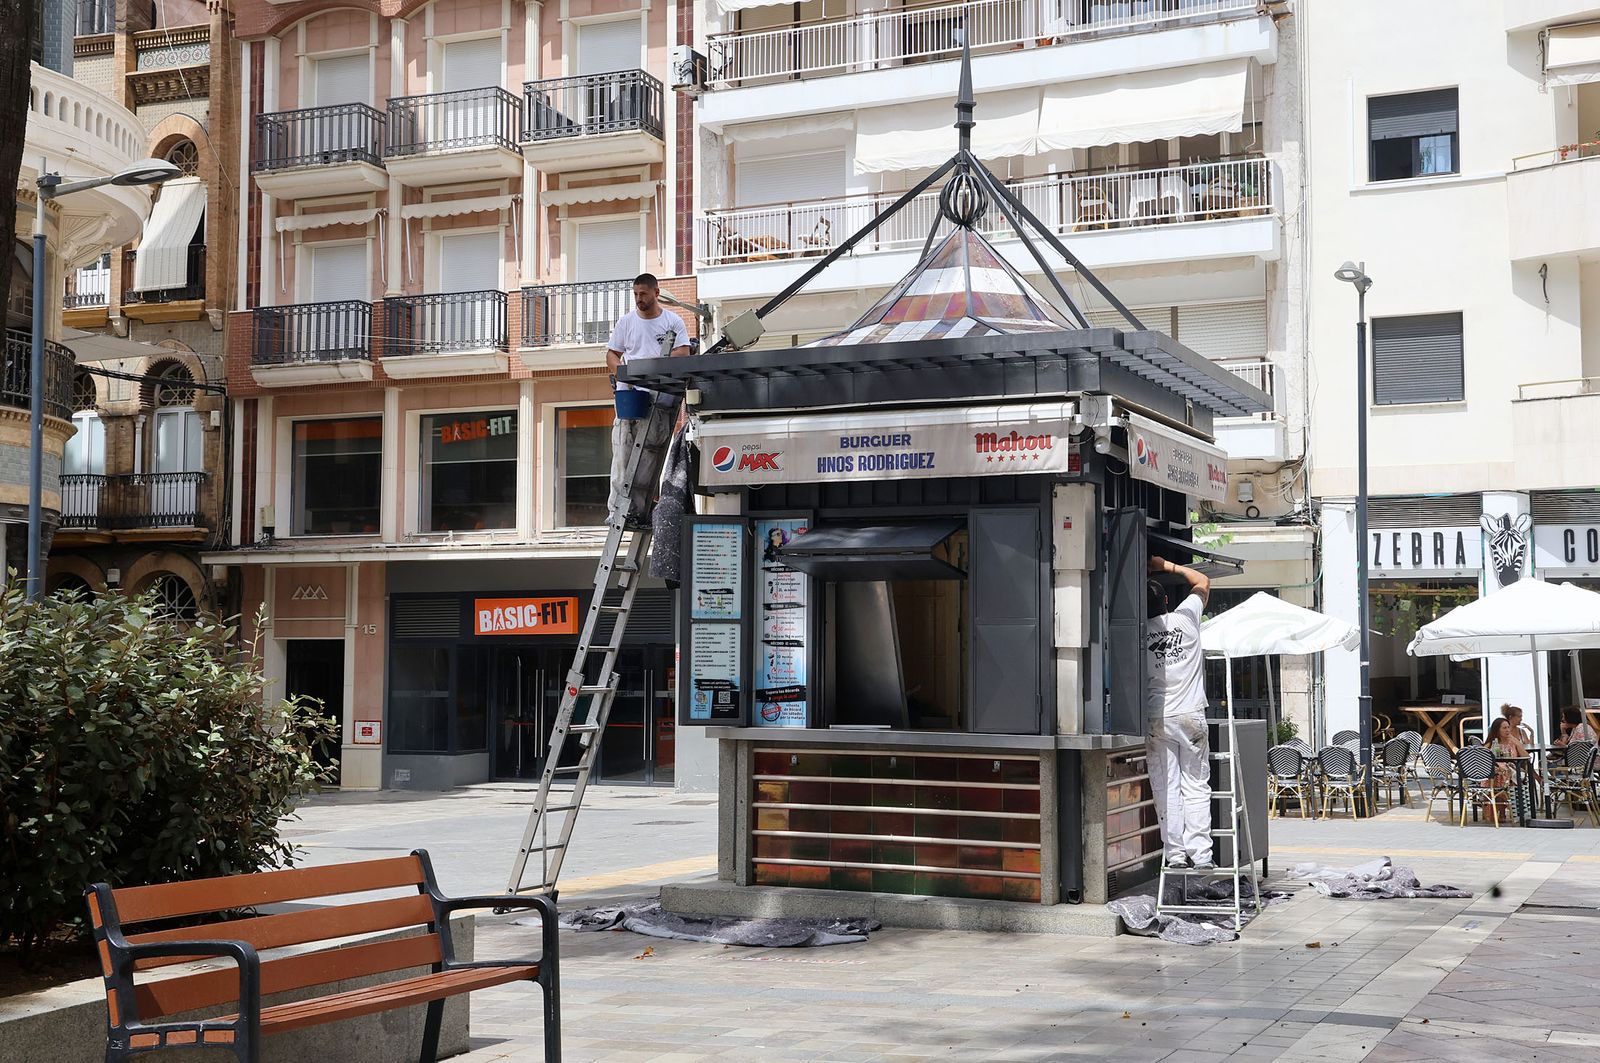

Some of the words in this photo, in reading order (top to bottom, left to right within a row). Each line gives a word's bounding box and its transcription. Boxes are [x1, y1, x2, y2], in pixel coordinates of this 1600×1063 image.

[741, 443, 762, 451] pepsi
[840, 434, 911, 448] BURGUER
[974, 430, 1053, 453] Mahou
[738, 452, 782, 471] MAX
[817, 456, 854, 473] HNOS
[858, 452, 935, 471] RODRIGUEZ
[1373, 531, 1466, 566] ZEBRA
[1563, 528, 1598, 563] CO
[362, 624, 377, 635] 15
